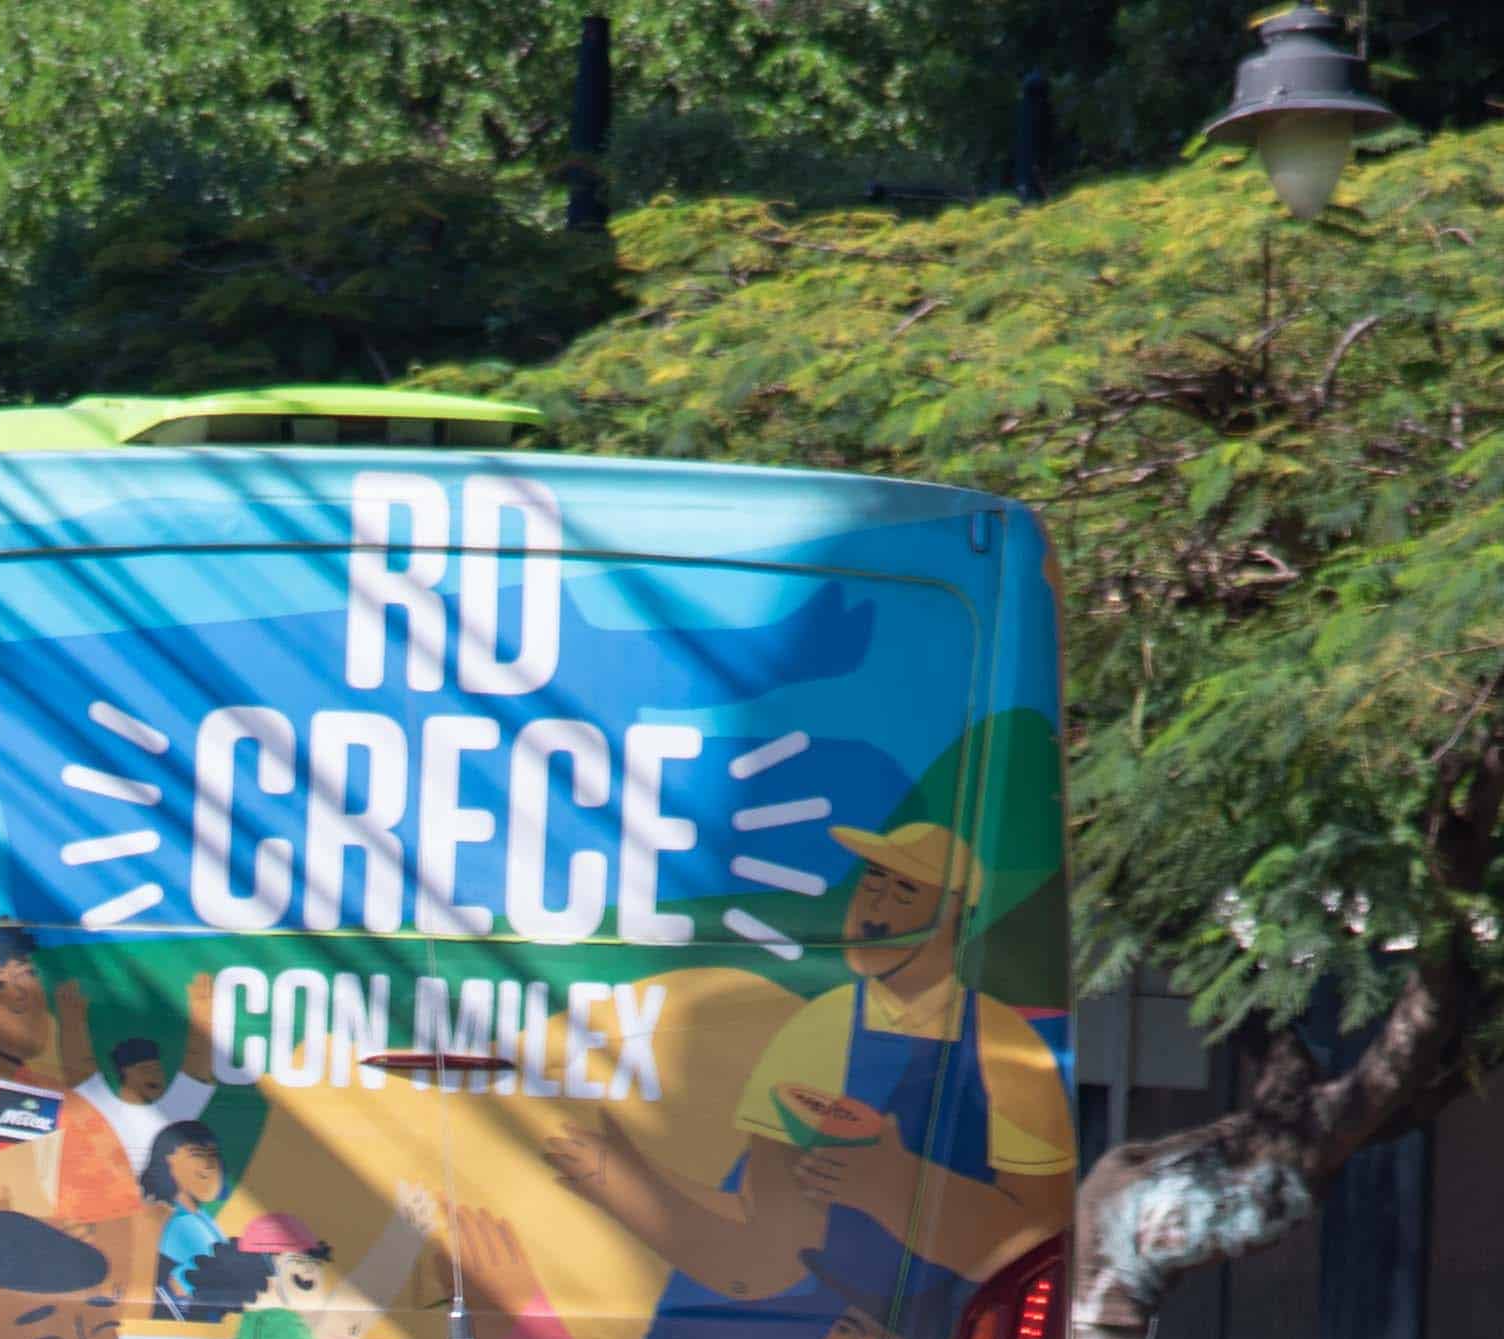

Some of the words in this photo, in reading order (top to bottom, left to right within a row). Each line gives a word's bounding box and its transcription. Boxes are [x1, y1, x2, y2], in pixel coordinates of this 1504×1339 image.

[344, 471, 561, 696] RD
[189, 705, 702, 946] CRECE
[211, 966, 391, 1090] CON
[412, 975, 668, 1101] MILEX
